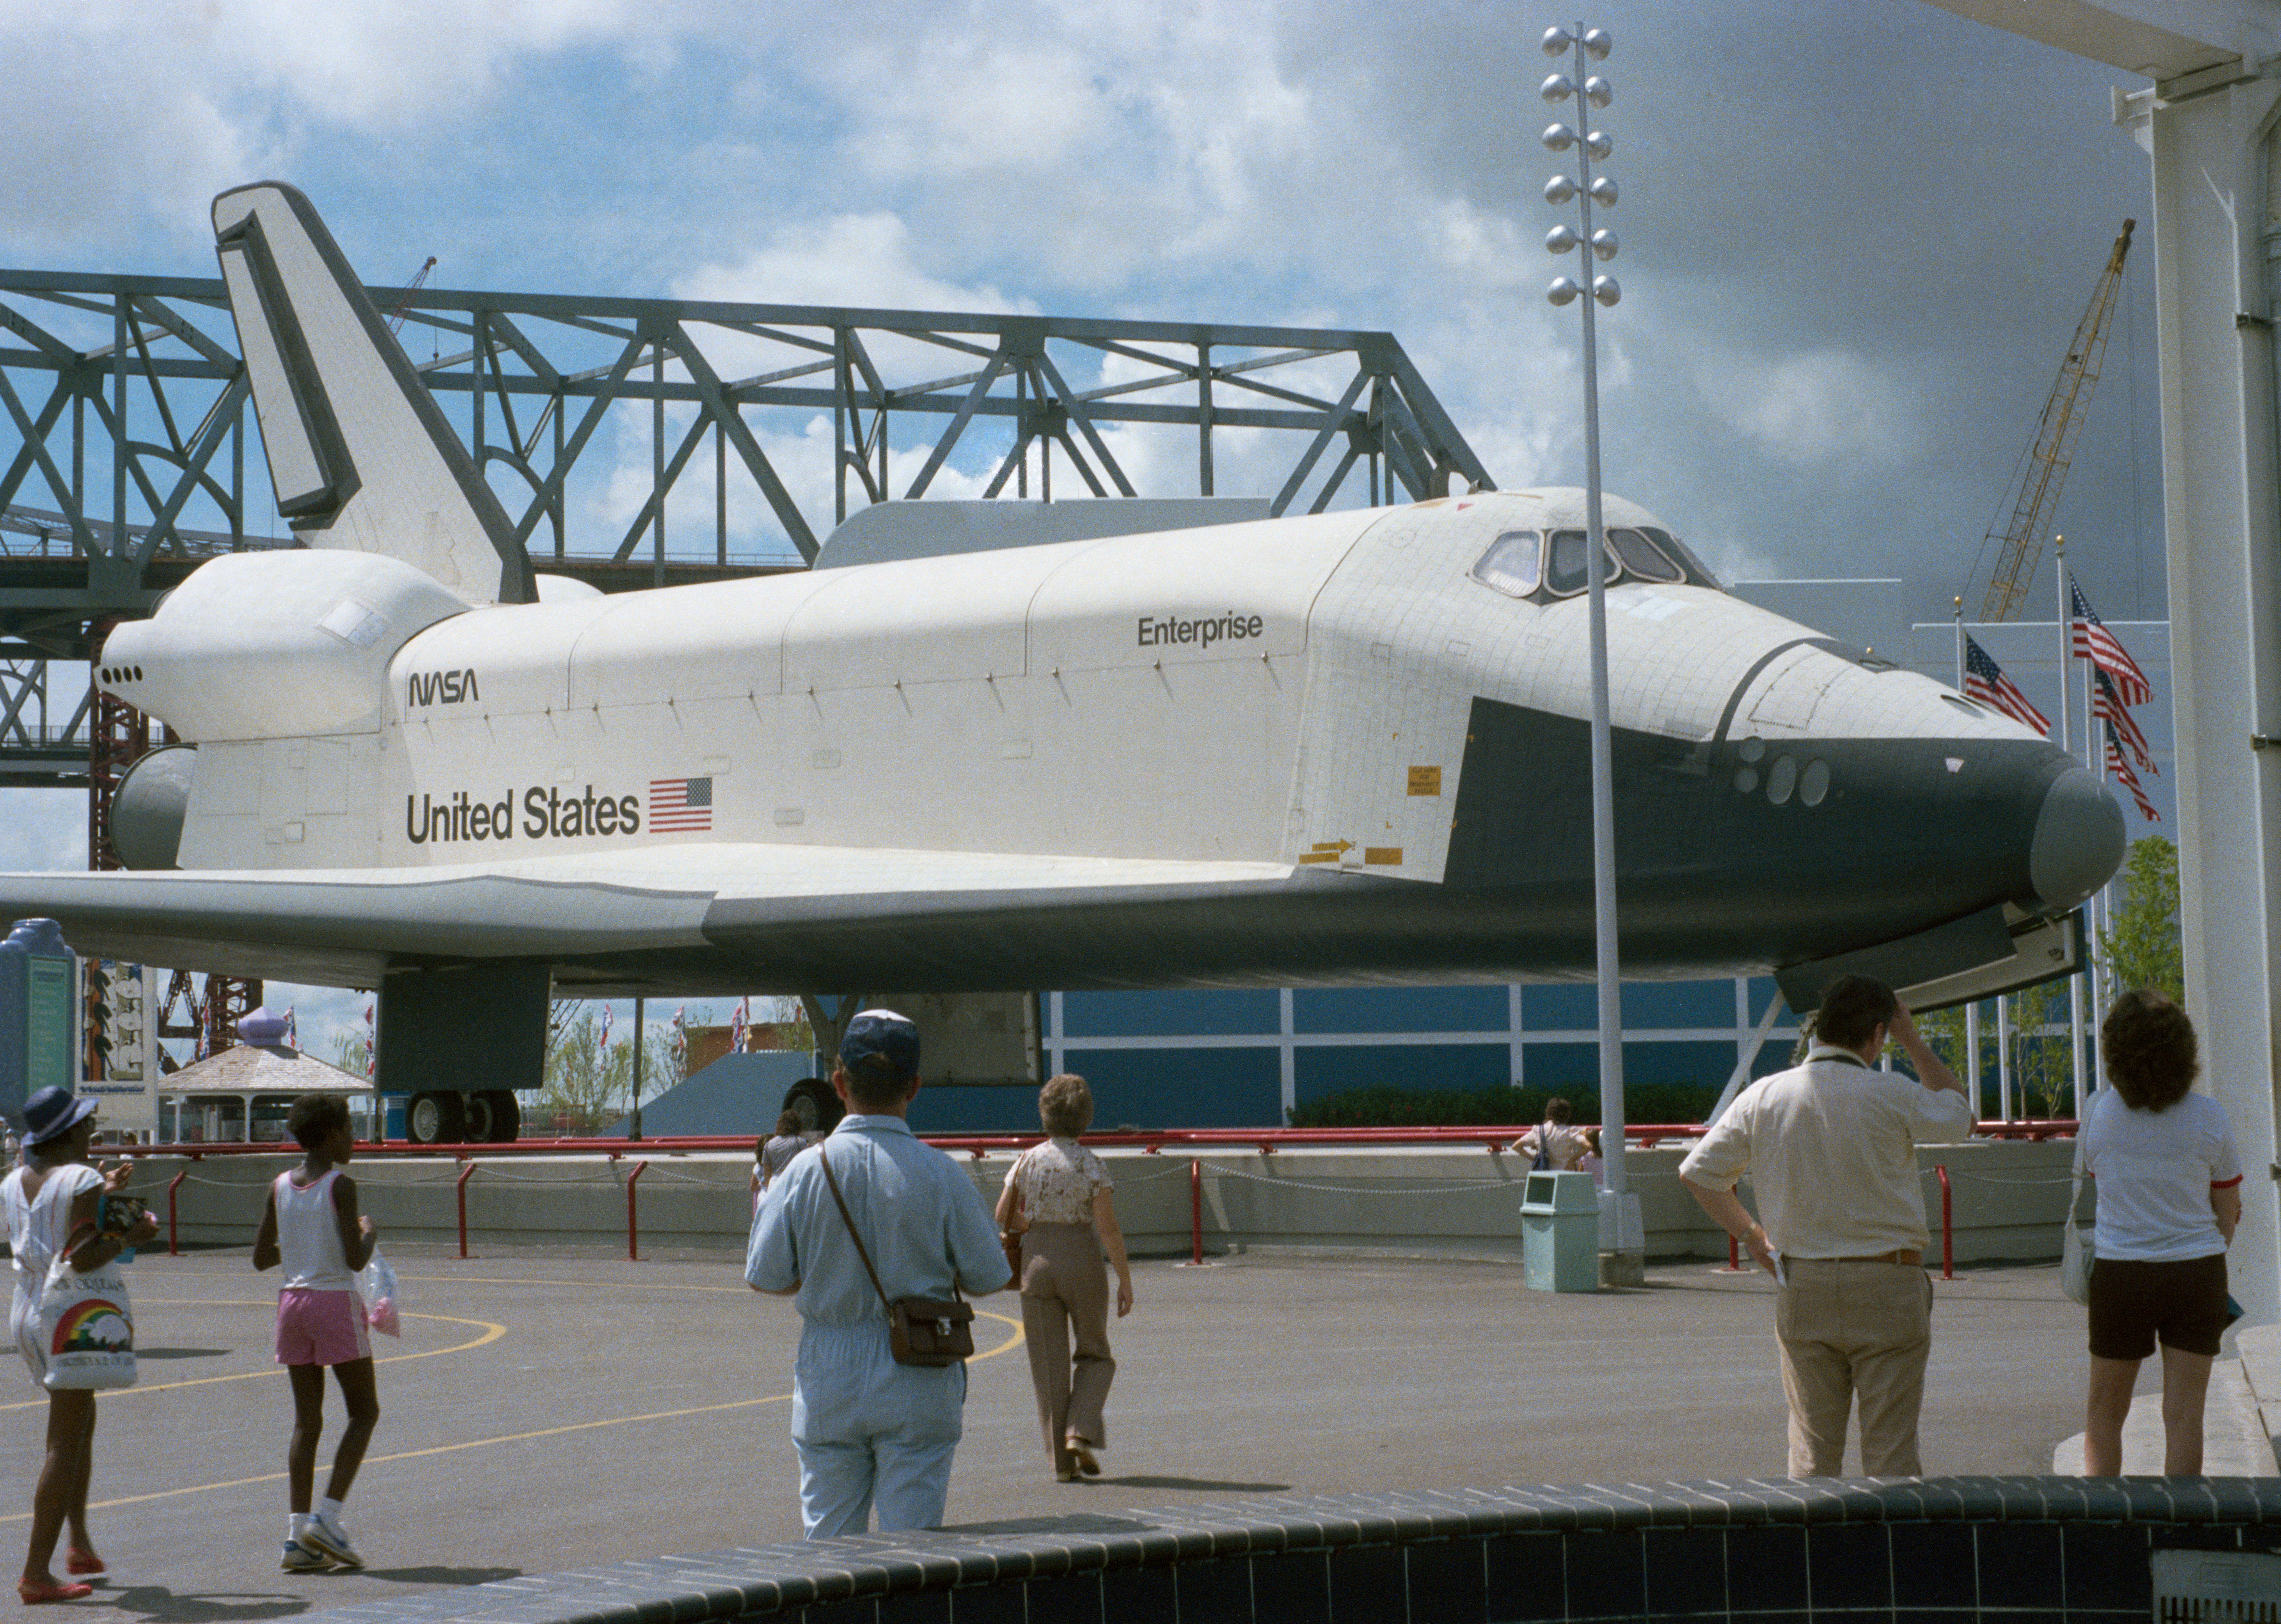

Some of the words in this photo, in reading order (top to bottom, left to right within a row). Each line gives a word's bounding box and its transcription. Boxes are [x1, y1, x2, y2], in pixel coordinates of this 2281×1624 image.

[1138, 610, 1263, 649] Enterprise
[409, 669, 479, 707] NASA
[407, 789, 513, 844] United
[523, 785, 640, 839] States
